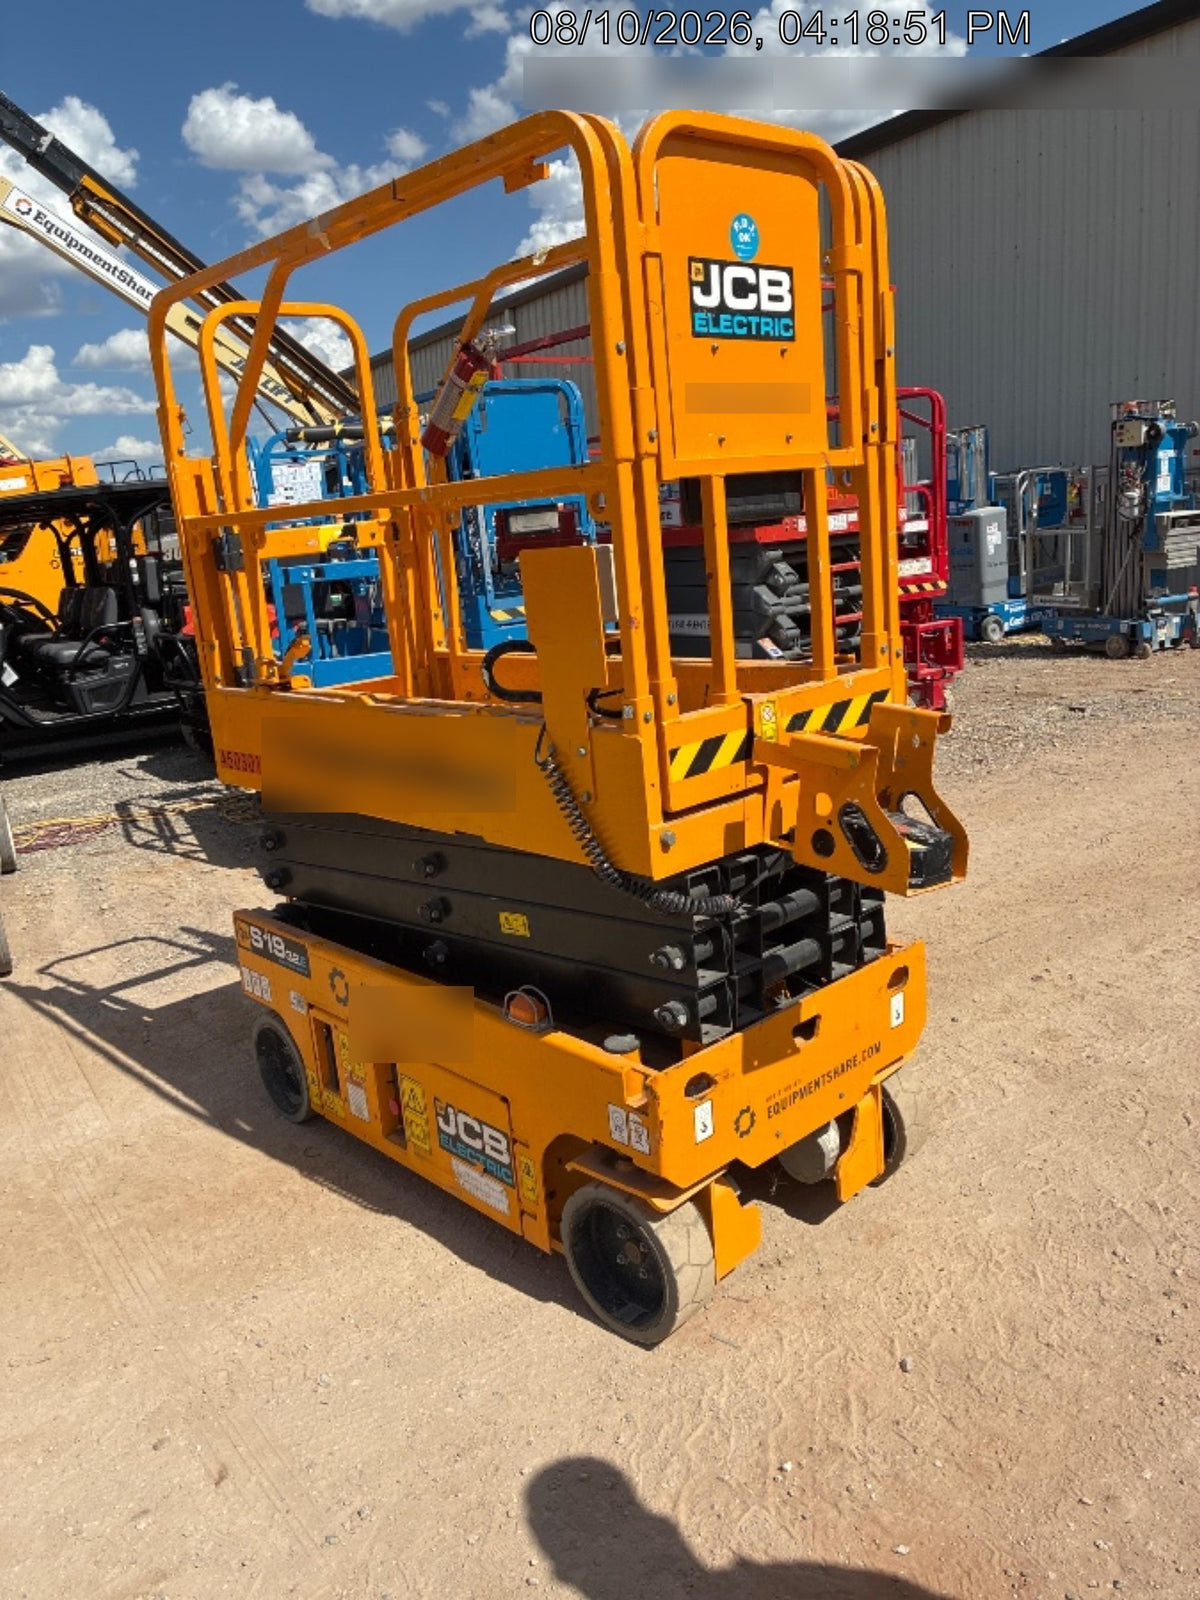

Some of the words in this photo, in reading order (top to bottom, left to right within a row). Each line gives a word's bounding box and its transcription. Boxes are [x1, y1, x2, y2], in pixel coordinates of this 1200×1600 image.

[33, 209, 154, 301] EquipmentShar
[738, 232, 752, 243] OK
[692, 264, 792, 312] JCB
[694, 312, 794, 337] ELECTRIC
[767, 1040, 882, 1119] EQUIPMENTSHARE.COM
[437, 1105, 511, 1165] JCB
[440, 1133, 514, 1185] ELECTRIC
